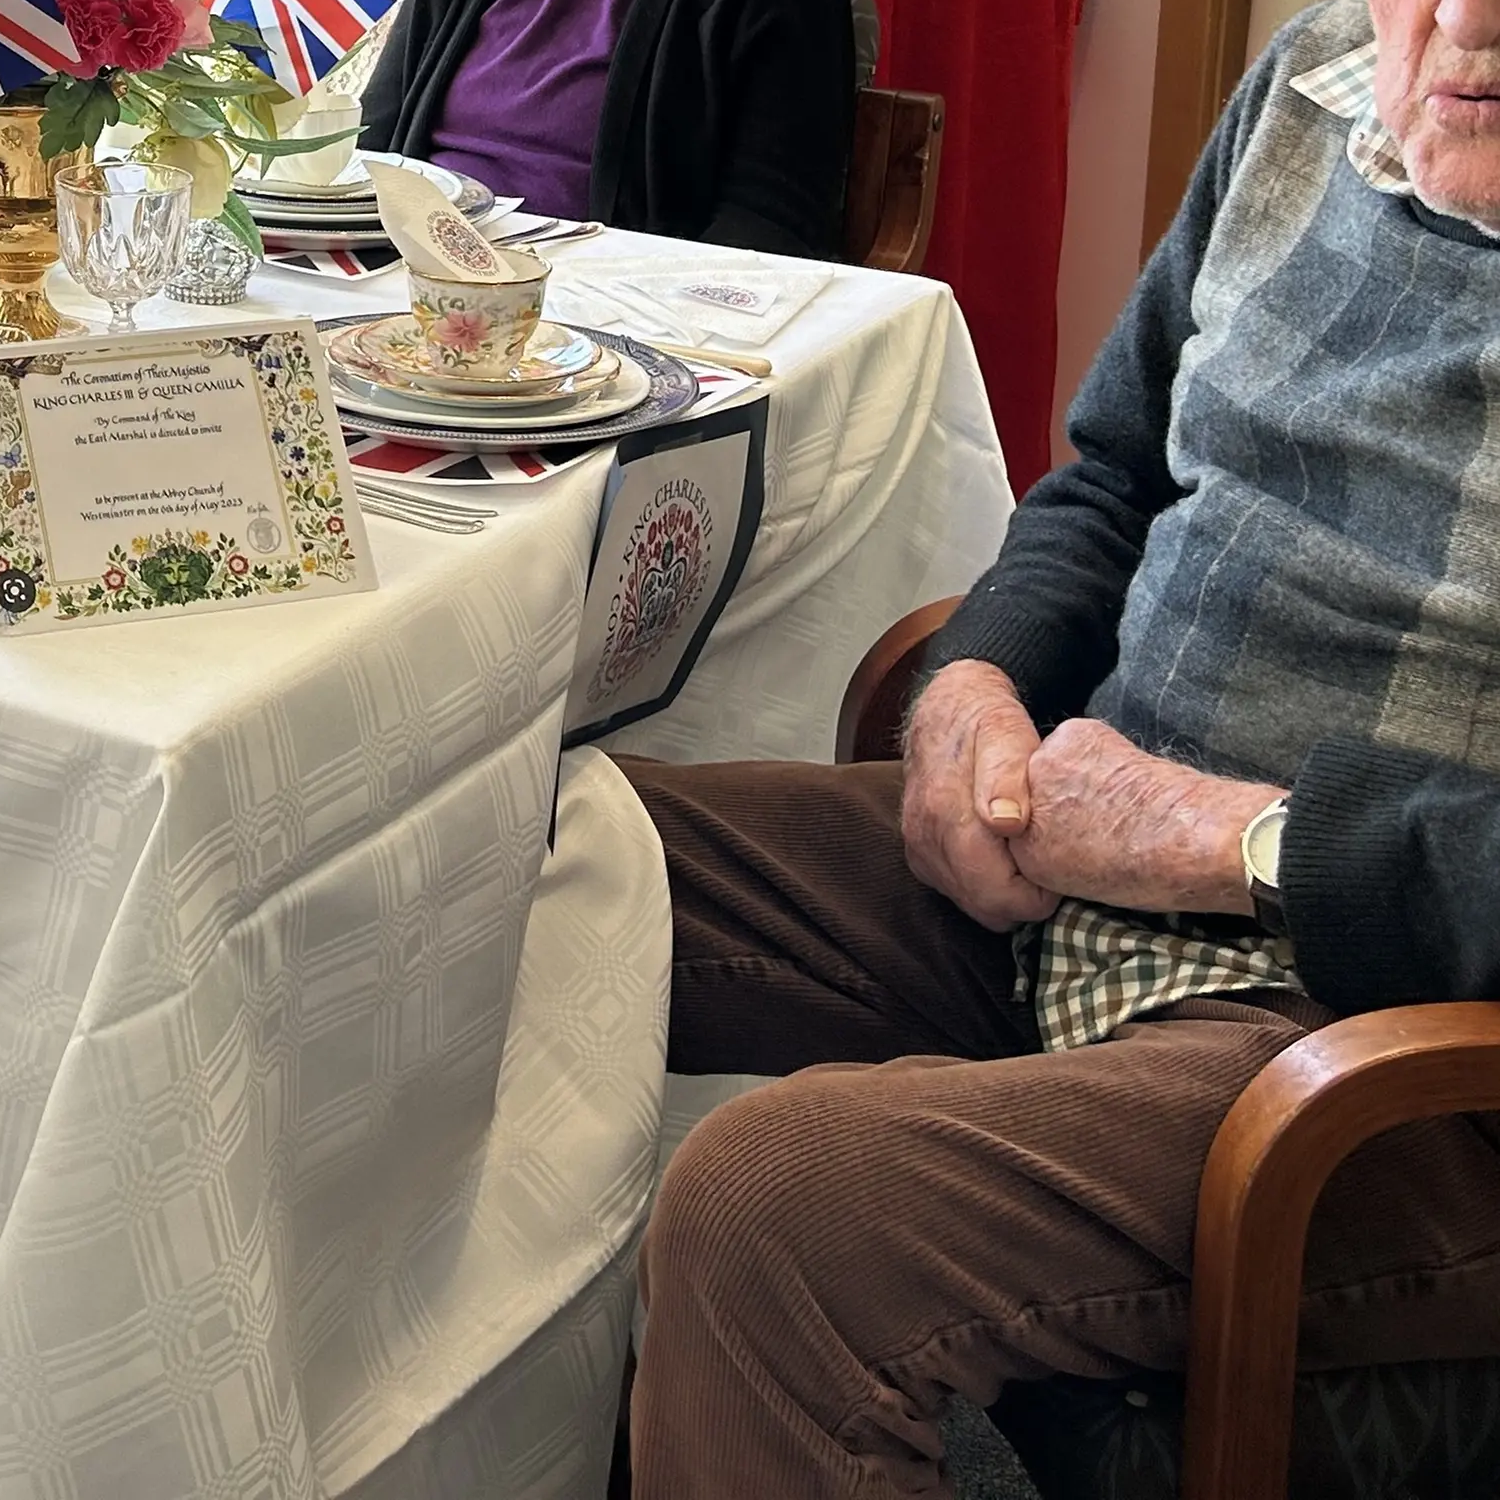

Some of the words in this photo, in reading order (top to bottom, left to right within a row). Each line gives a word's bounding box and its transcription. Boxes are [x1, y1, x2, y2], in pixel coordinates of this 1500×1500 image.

[61, 371, 80, 386] The
[84, 371, 132, 385] Coronation
[134, 367, 143, 384] of
[143, 363, 169, 379] Their
[169, 364, 211, 379] Majesties
[33, 395, 68, 410] KING
[69, 390, 122, 405] CHARLES
[124, 389, 134, 400] III
[137, 386, 149, 400] &
[152, 383, 193, 400] QUEEN
[194, 378, 245, 393] CAMILLA
[94, 416, 110, 428] By
[112, 412, 150, 424] Command
[152, 406, 159, 424] of
[160, 407, 174, 420] The
[175, 410, 196, 422] King
[74, 435, 87, 445] the
[88, 432, 107, 443] Earl
[109, 429, 147, 441] Marshal
[150, 431, 157, 439] is
[158, 426, 190, 438] directed
[191, 427, 199, 435] to
[199, 424, 222, 434] invite
[103, 495, 111, 503] be
[112, 493, 139, 506] present
[140, 492, 149, 500] at
[149, 489, 160, 499] the
[161, 487, 186, 500] Abbey
[188, 484, 216, 496] Church
[217, 481, 224, 497] of
[80, 508, 134, 521] Westminster
[137, 508, 146, 516] on
[148, 506, 159, 515] the
[175, 503, 189, 516] day
[190, 499, 197, 515] of
[199, 501, 219, 514] May
[221, 497, 243, 508] 2023
[623, 502, 652, 565] KING
[655, 478, 706, 514] CHARLES
[702, 508, 713, 539] III
